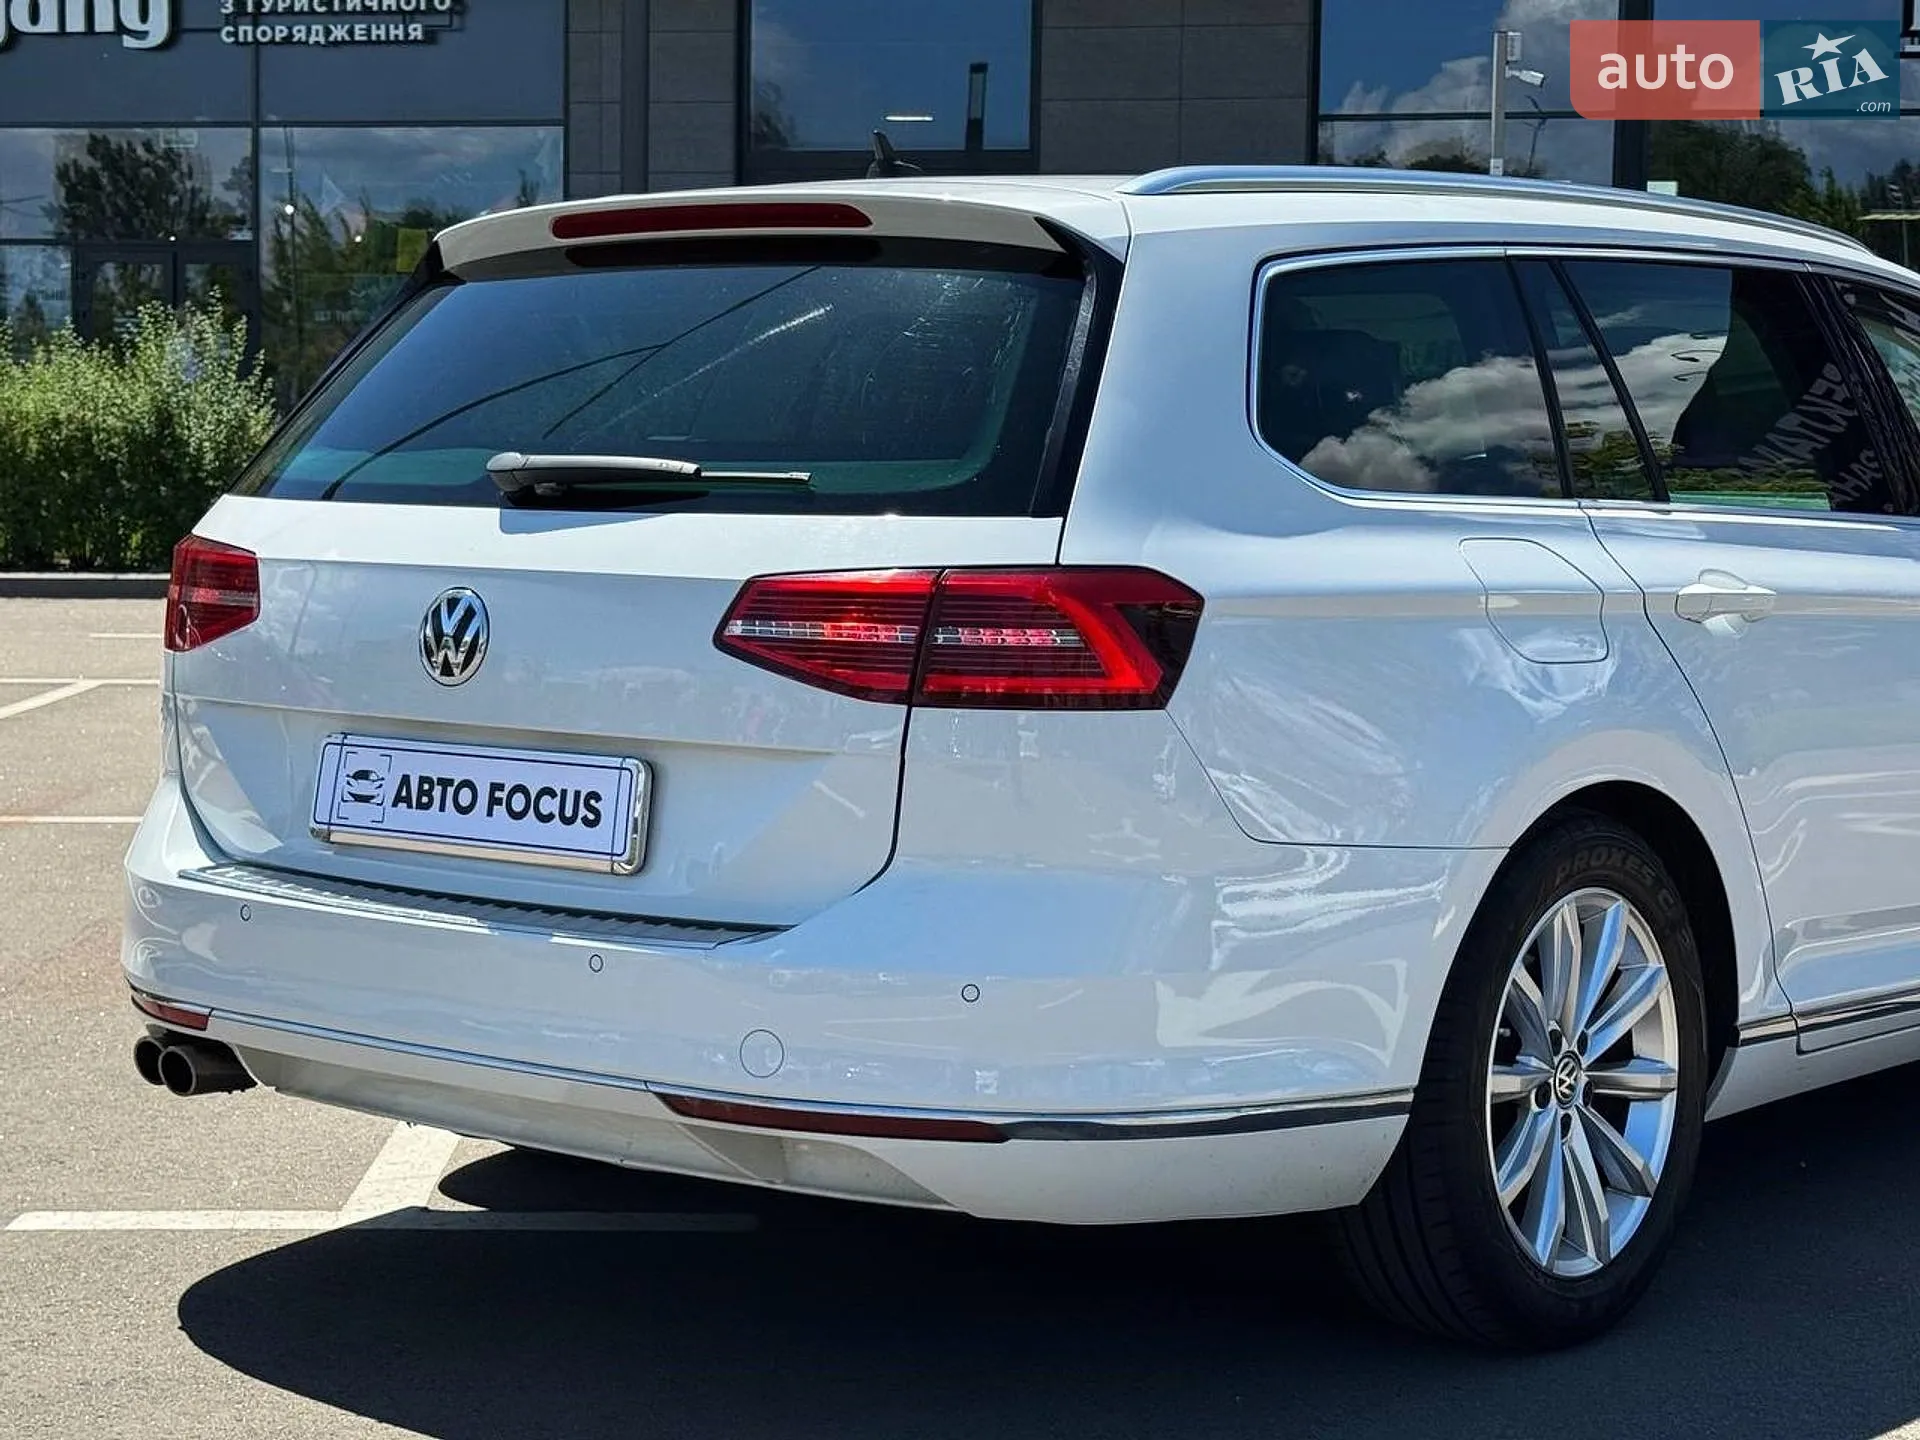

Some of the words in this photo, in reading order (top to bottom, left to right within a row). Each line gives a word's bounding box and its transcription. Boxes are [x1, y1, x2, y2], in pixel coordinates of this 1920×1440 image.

[220, 24, 423, 44] СПОРЯДЖЕННЯ
[391, 774, 478, 816] АВТО
[486, 782, 603, 829] FOCUS
